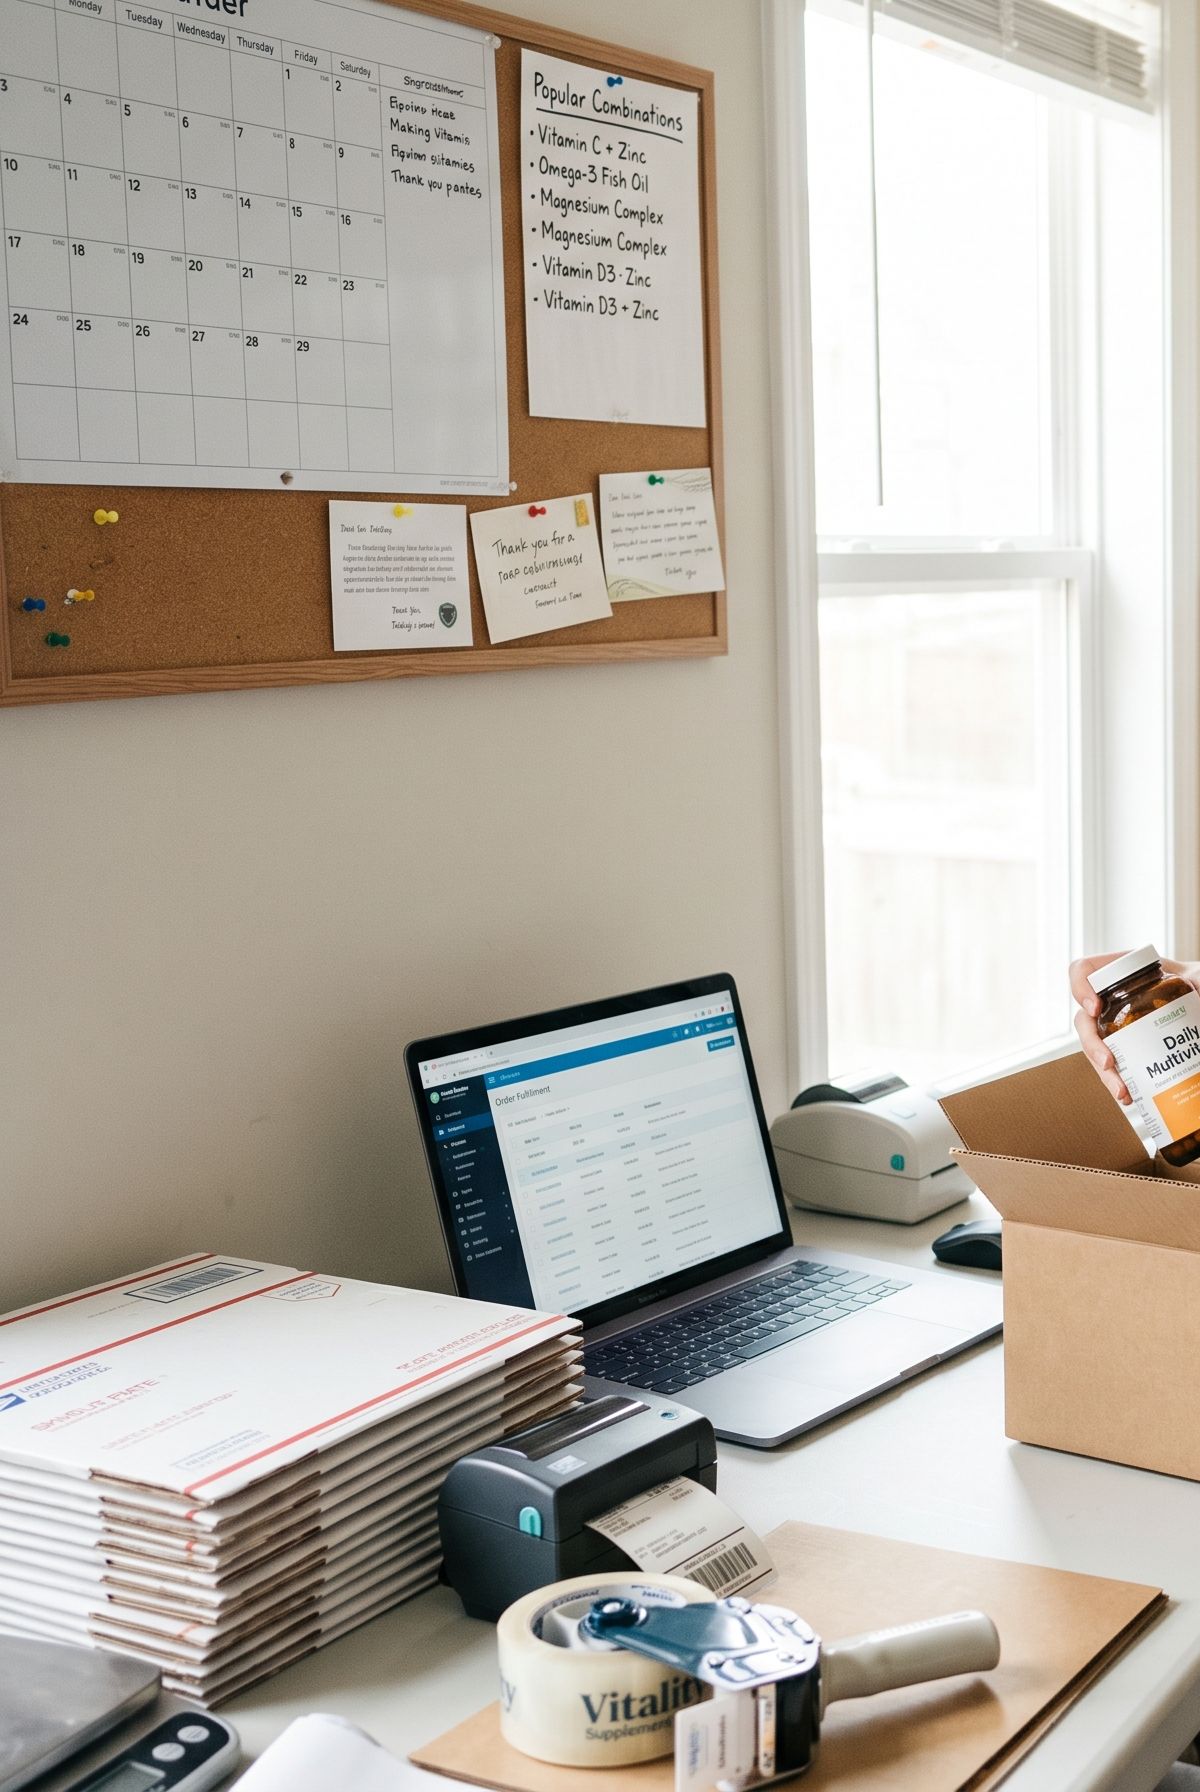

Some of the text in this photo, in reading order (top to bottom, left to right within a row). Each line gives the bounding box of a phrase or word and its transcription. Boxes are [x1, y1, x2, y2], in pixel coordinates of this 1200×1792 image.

[69, 0, 103, 15] Monday
[125, 10, 163, 29] Tuesday
[177, 21, 226, 44] Wednesday
[236, 36, 274, 56] Thursday
[294, 50, 318, 66] Friday
[286, 69, 291, 80] 1
[340, 61, 371, 79] Saturday
[0, 78, 8, 92] 3
[336, 80, 342, 92] 2
[63, 93, 72, 105] 4
[534, 71, 683, 132] Popular Combinations
[124, 104, 131, 117] 5
[182, 116, 189, 129] 6
[237, 126, 244, 139] 7
[390, 117, 431, 143] Making
[289, 138, 295, 150] 8
[538, 123, 647, 165] Vitamin C + Zinc
[338, 147, 344, 159] 9
[4, 158, 18, 172] 10
[67, 168, 78, 181] 11
[539, 155, 649, 193] Omega-3 Fish Oil
[128, 179, 141, 193] 12
[391, 169, 482, 199] Thank you pantes
[185, 188, 197, 201] 13
[239, 196, 251, 210] 14
[540, 187, 664, 228] Magnesium Complex
[291, 206, 303, 219] 15
[340, 213, 351, 227] 16
[8, 235, 21, 250] 17
[542, 220, 667, 260] Magnesium Complex
[72, 243, 86, 258] 18
[131, 251, 145, 266] 19
[188, 259, 203, 273] 20
[241, 266, 254, 280] 21
[542, 254, 652, 288] Vitamin D3 Zinc
[294, 273, 308, 287] 22
[342, 279, 355, 293] 23
[544, 289, 660, 322] Vitamin D3 + Zinc
[12, 312, 29, 327] 24
[76, 318, 92, 333] 25
[135, 324, 151, 339] 26
[191, 330, 206, 344] 27
[245, 335, 259, 349] 28
[296, 340, 310, 354] 29
[491, 537, 528, 558] Thank
[532, 540, 548, 559] you
[1162, 1024, 1200, 1051] Daily
[495, 1094, 516, 1107] Order
